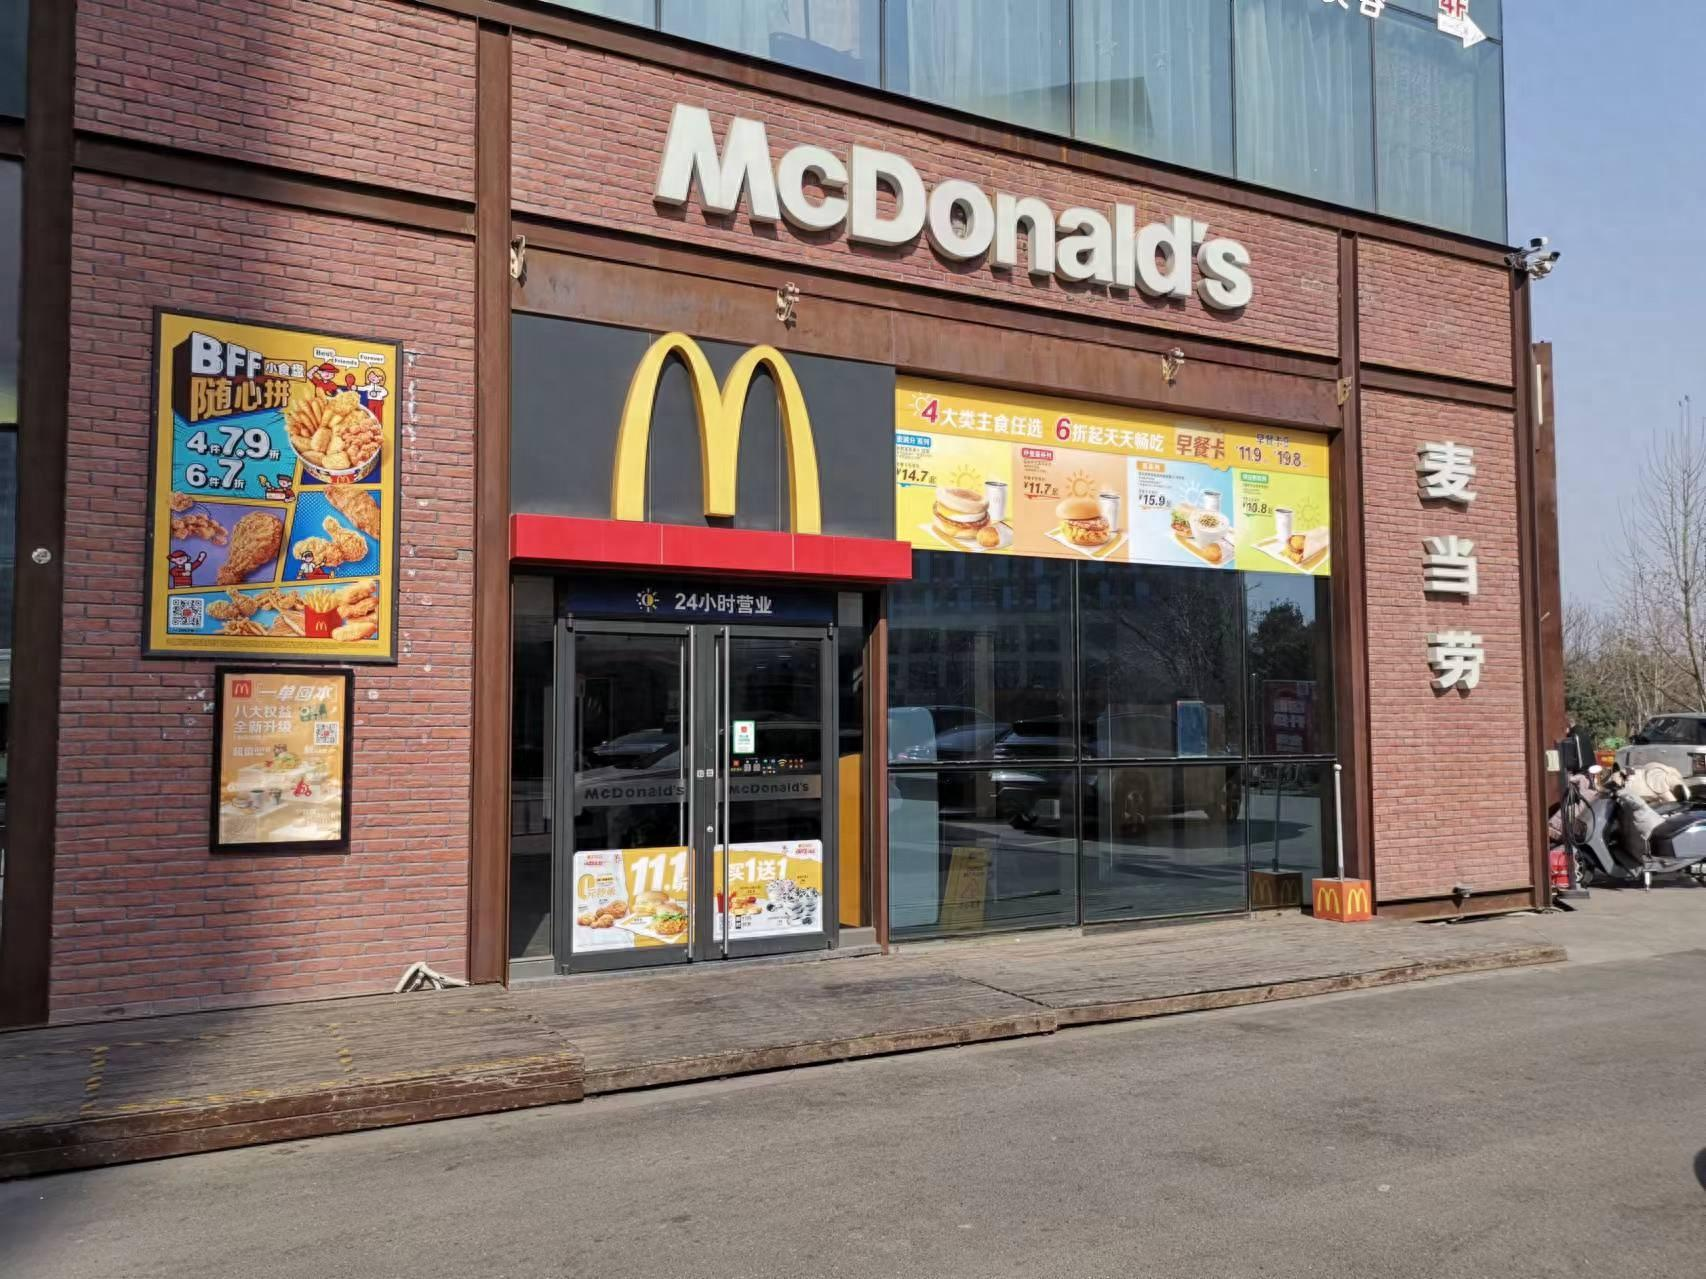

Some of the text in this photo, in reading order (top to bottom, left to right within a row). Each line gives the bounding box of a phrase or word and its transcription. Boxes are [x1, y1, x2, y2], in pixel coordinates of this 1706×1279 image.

[653, 103, 1253, 311] McDonald's
[191, 331, 263, 378] BFF
[190, 376, 291, 423] 随心拼
[1416, 441, 1485, 689] 麦当劳
[674, 592, 773, 615] 24小时营业
[584, 784, 686, 800] McDonald's
[729, 782, 809, 795] McDonald's
